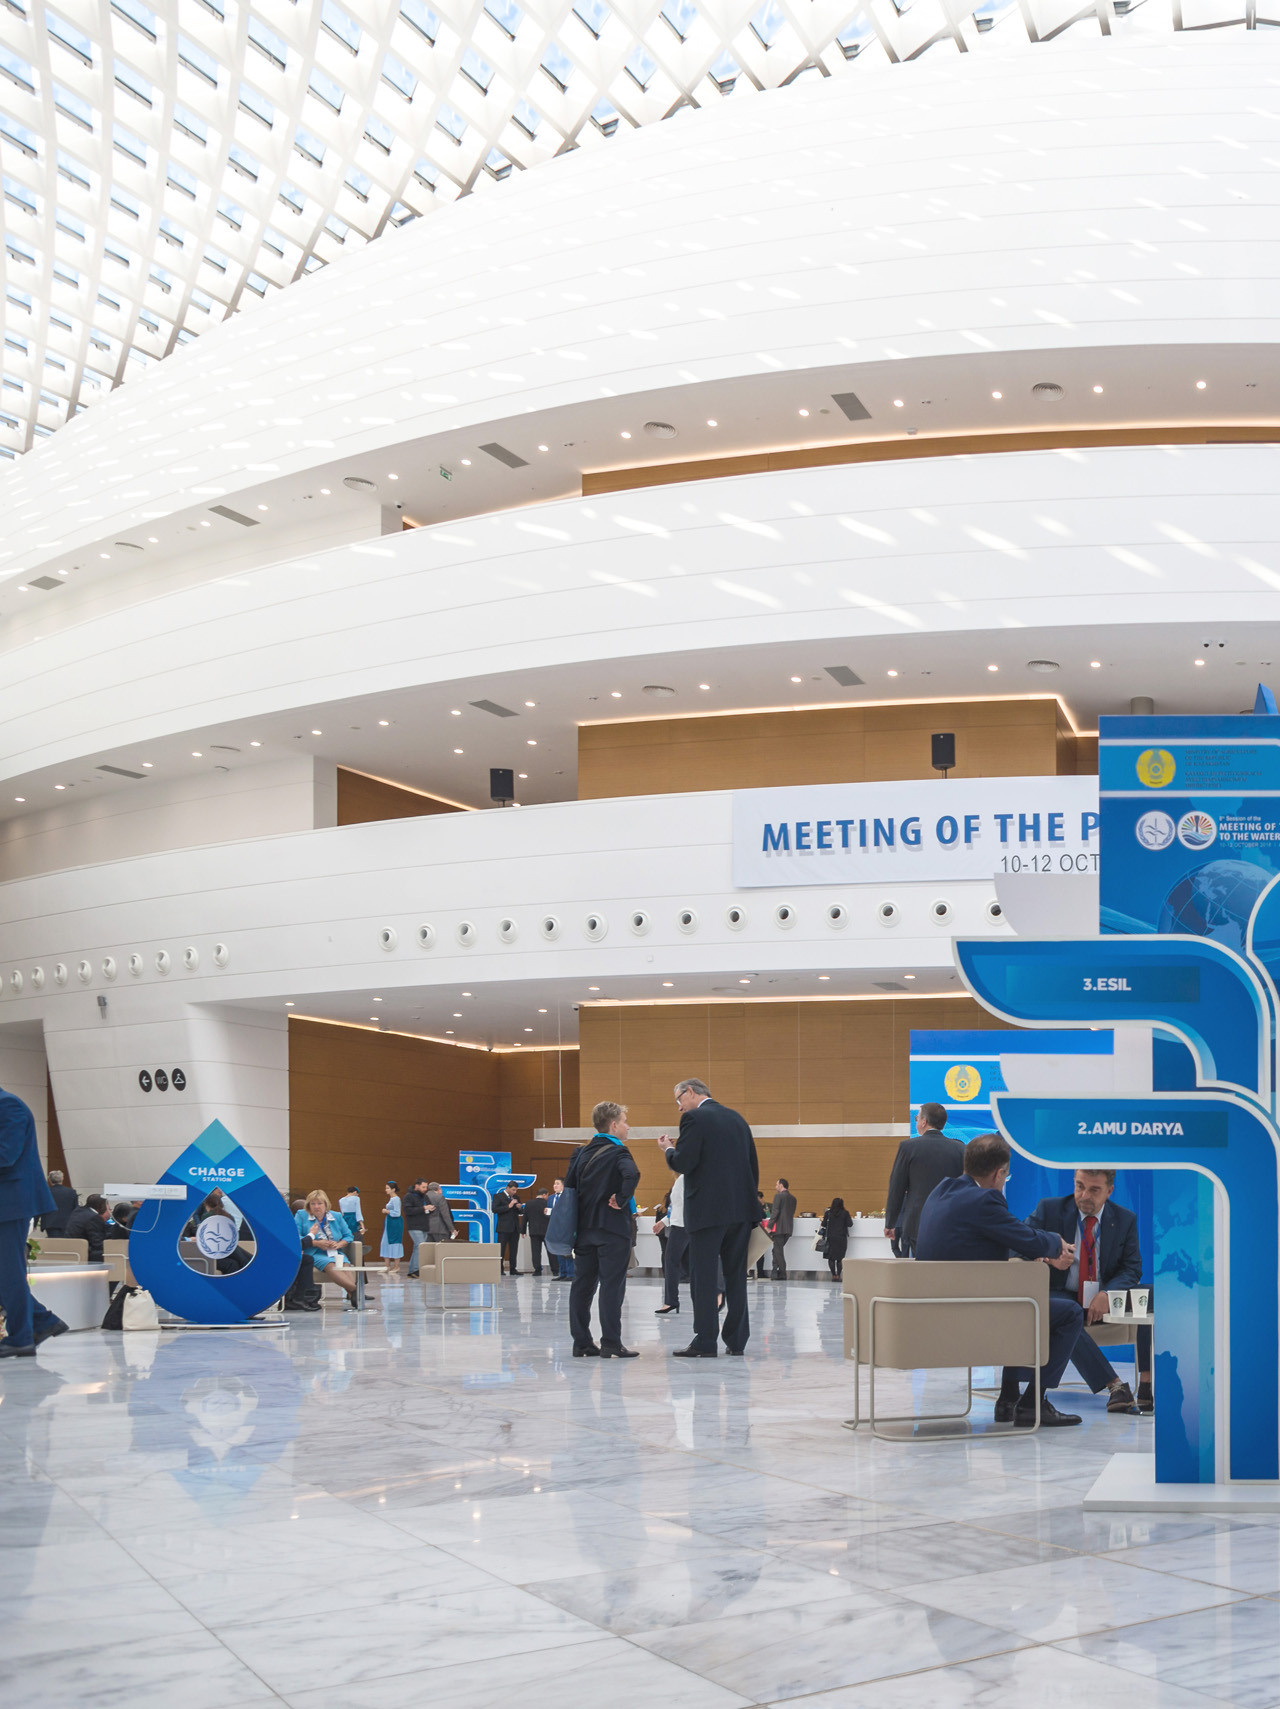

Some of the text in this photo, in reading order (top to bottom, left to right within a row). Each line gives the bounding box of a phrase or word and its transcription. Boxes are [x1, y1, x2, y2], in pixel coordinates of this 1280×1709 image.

[762, 816, 921, 851] MEETING
[935, 814, 980, 845] OF
[994, 812, 1064, 842] THE
[1219, 823, 1261, 831] MEETING
[1264, 823, 1276, 831] OF
[1219, 832, 1231, 840] TO
[1232, 832, 1249, 840] THE
[1250, 832, 1280, 840] WATER
[1001, 854, 1052, 873] 10-12
[1083, 977, 1131, 991] 3.ESIL
[156, 1076, 168, 1085] WC
[1077, 1122, 1184, 1136] 2.AMU DARYA
[188, 1166, 245, 1177] CHARGE
